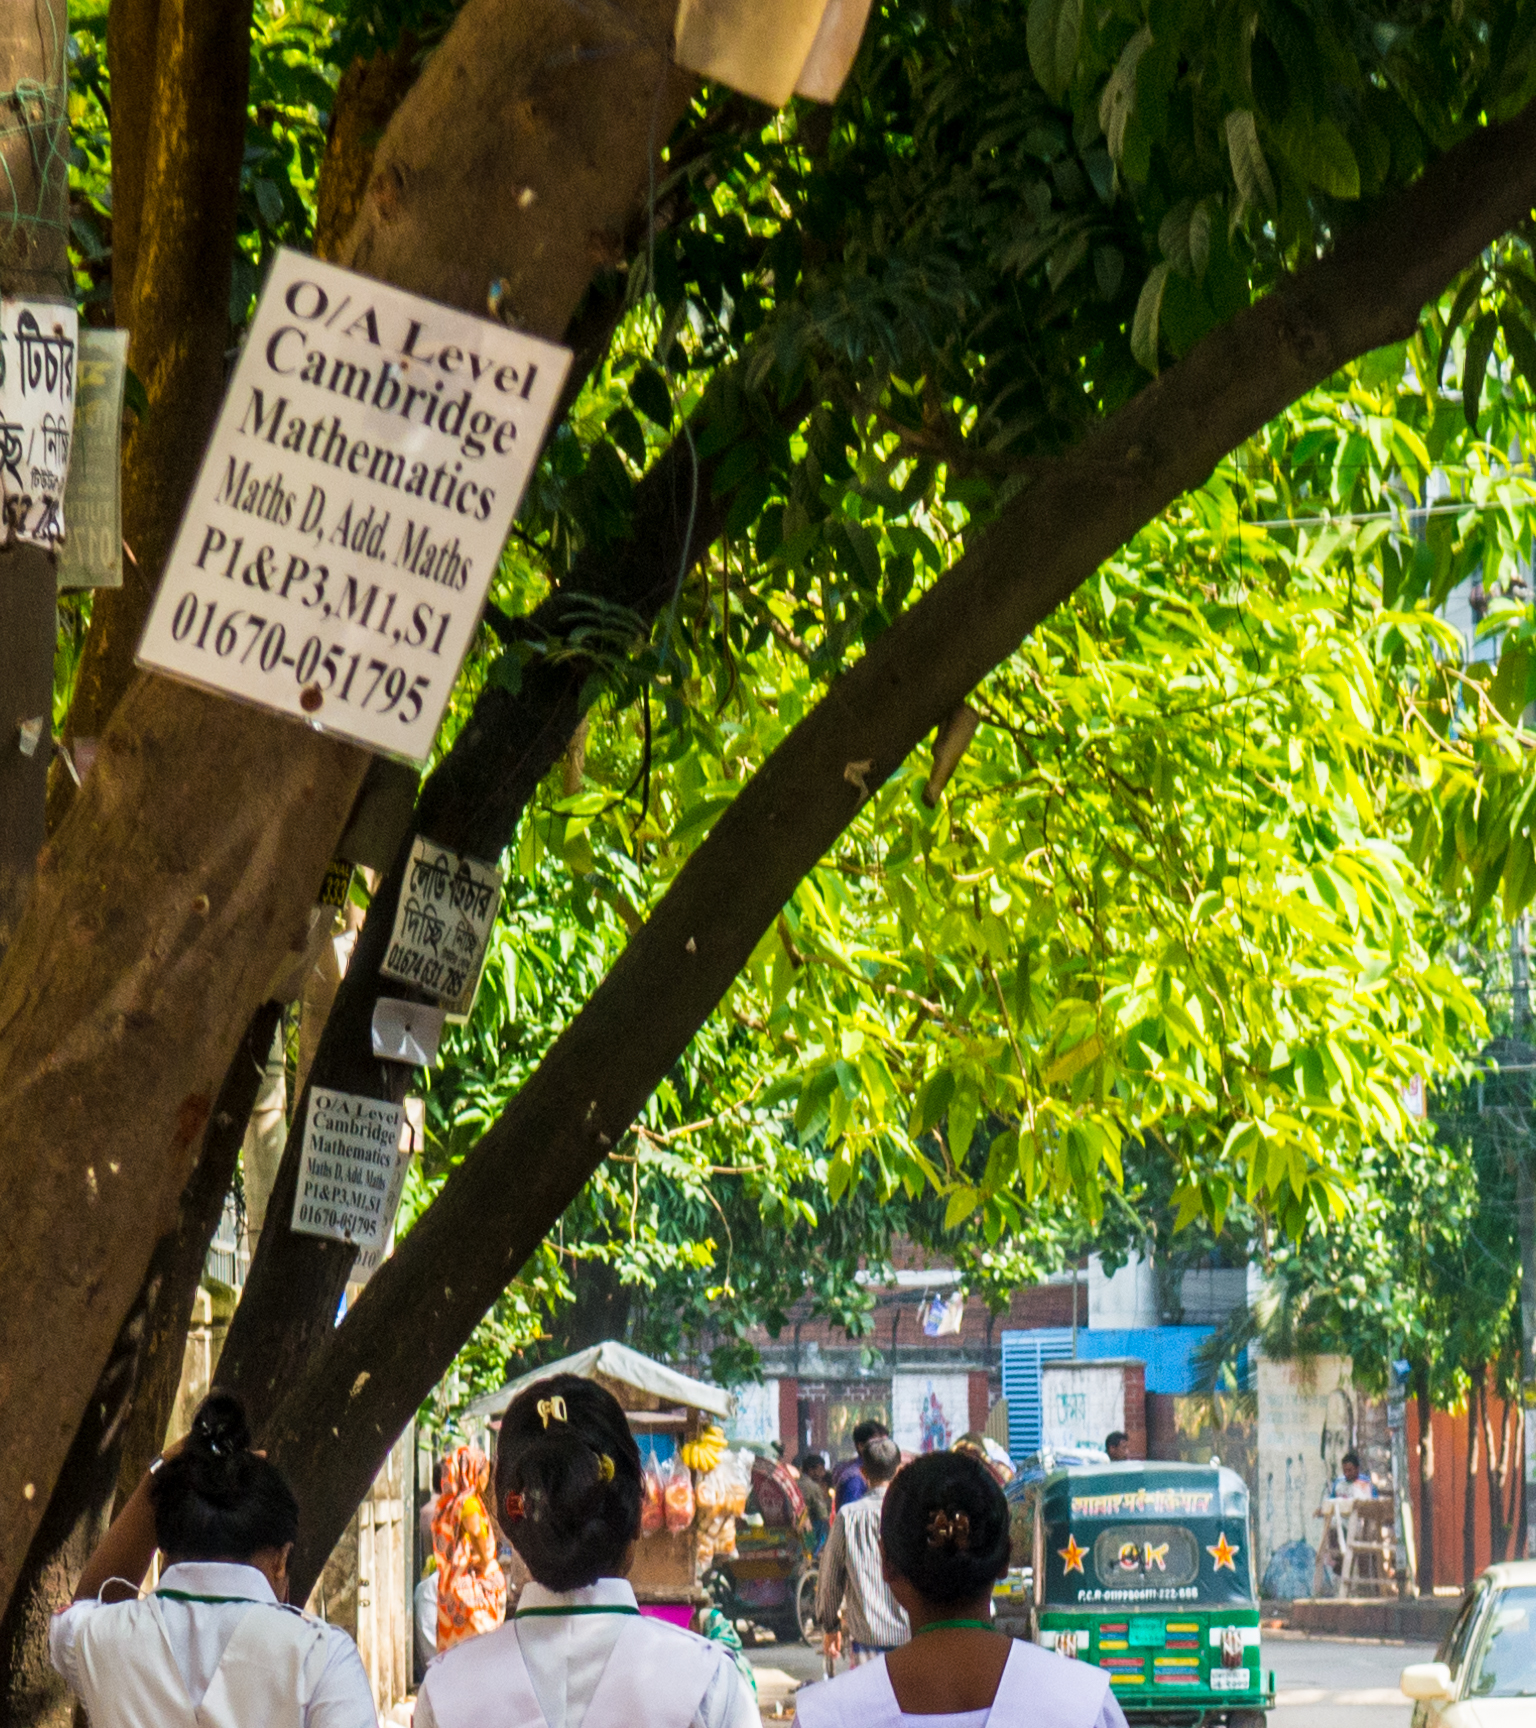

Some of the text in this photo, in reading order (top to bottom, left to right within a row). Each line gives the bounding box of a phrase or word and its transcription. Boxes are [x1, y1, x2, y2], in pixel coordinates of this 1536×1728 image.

[14, 309, 75, 403] টিচার
[285, 281, 538, 400] O/A Level
[267, 326, 517, 459] Cambridge
[237, 386, 495, 521] Mathematics
[215, 455, 473, 591] Maths D, Add. Maths
[193, 524, 452, 656] P1&P3,M1,S1
[172, 592, 430, 724] 01670-051795
[310, 1134, 391, 1168] Mathematics
[313, 1111, 396, 1146] Cambridge
[316, 1096, 399, 1125] O/A Level
[299, 1204, 377, 1237] 01670-051795
[307, 1157, 332, 1178] Maths
[366, 1170, 386, 1191] Maths
[1118, 1541, 1170, 1571] OK
